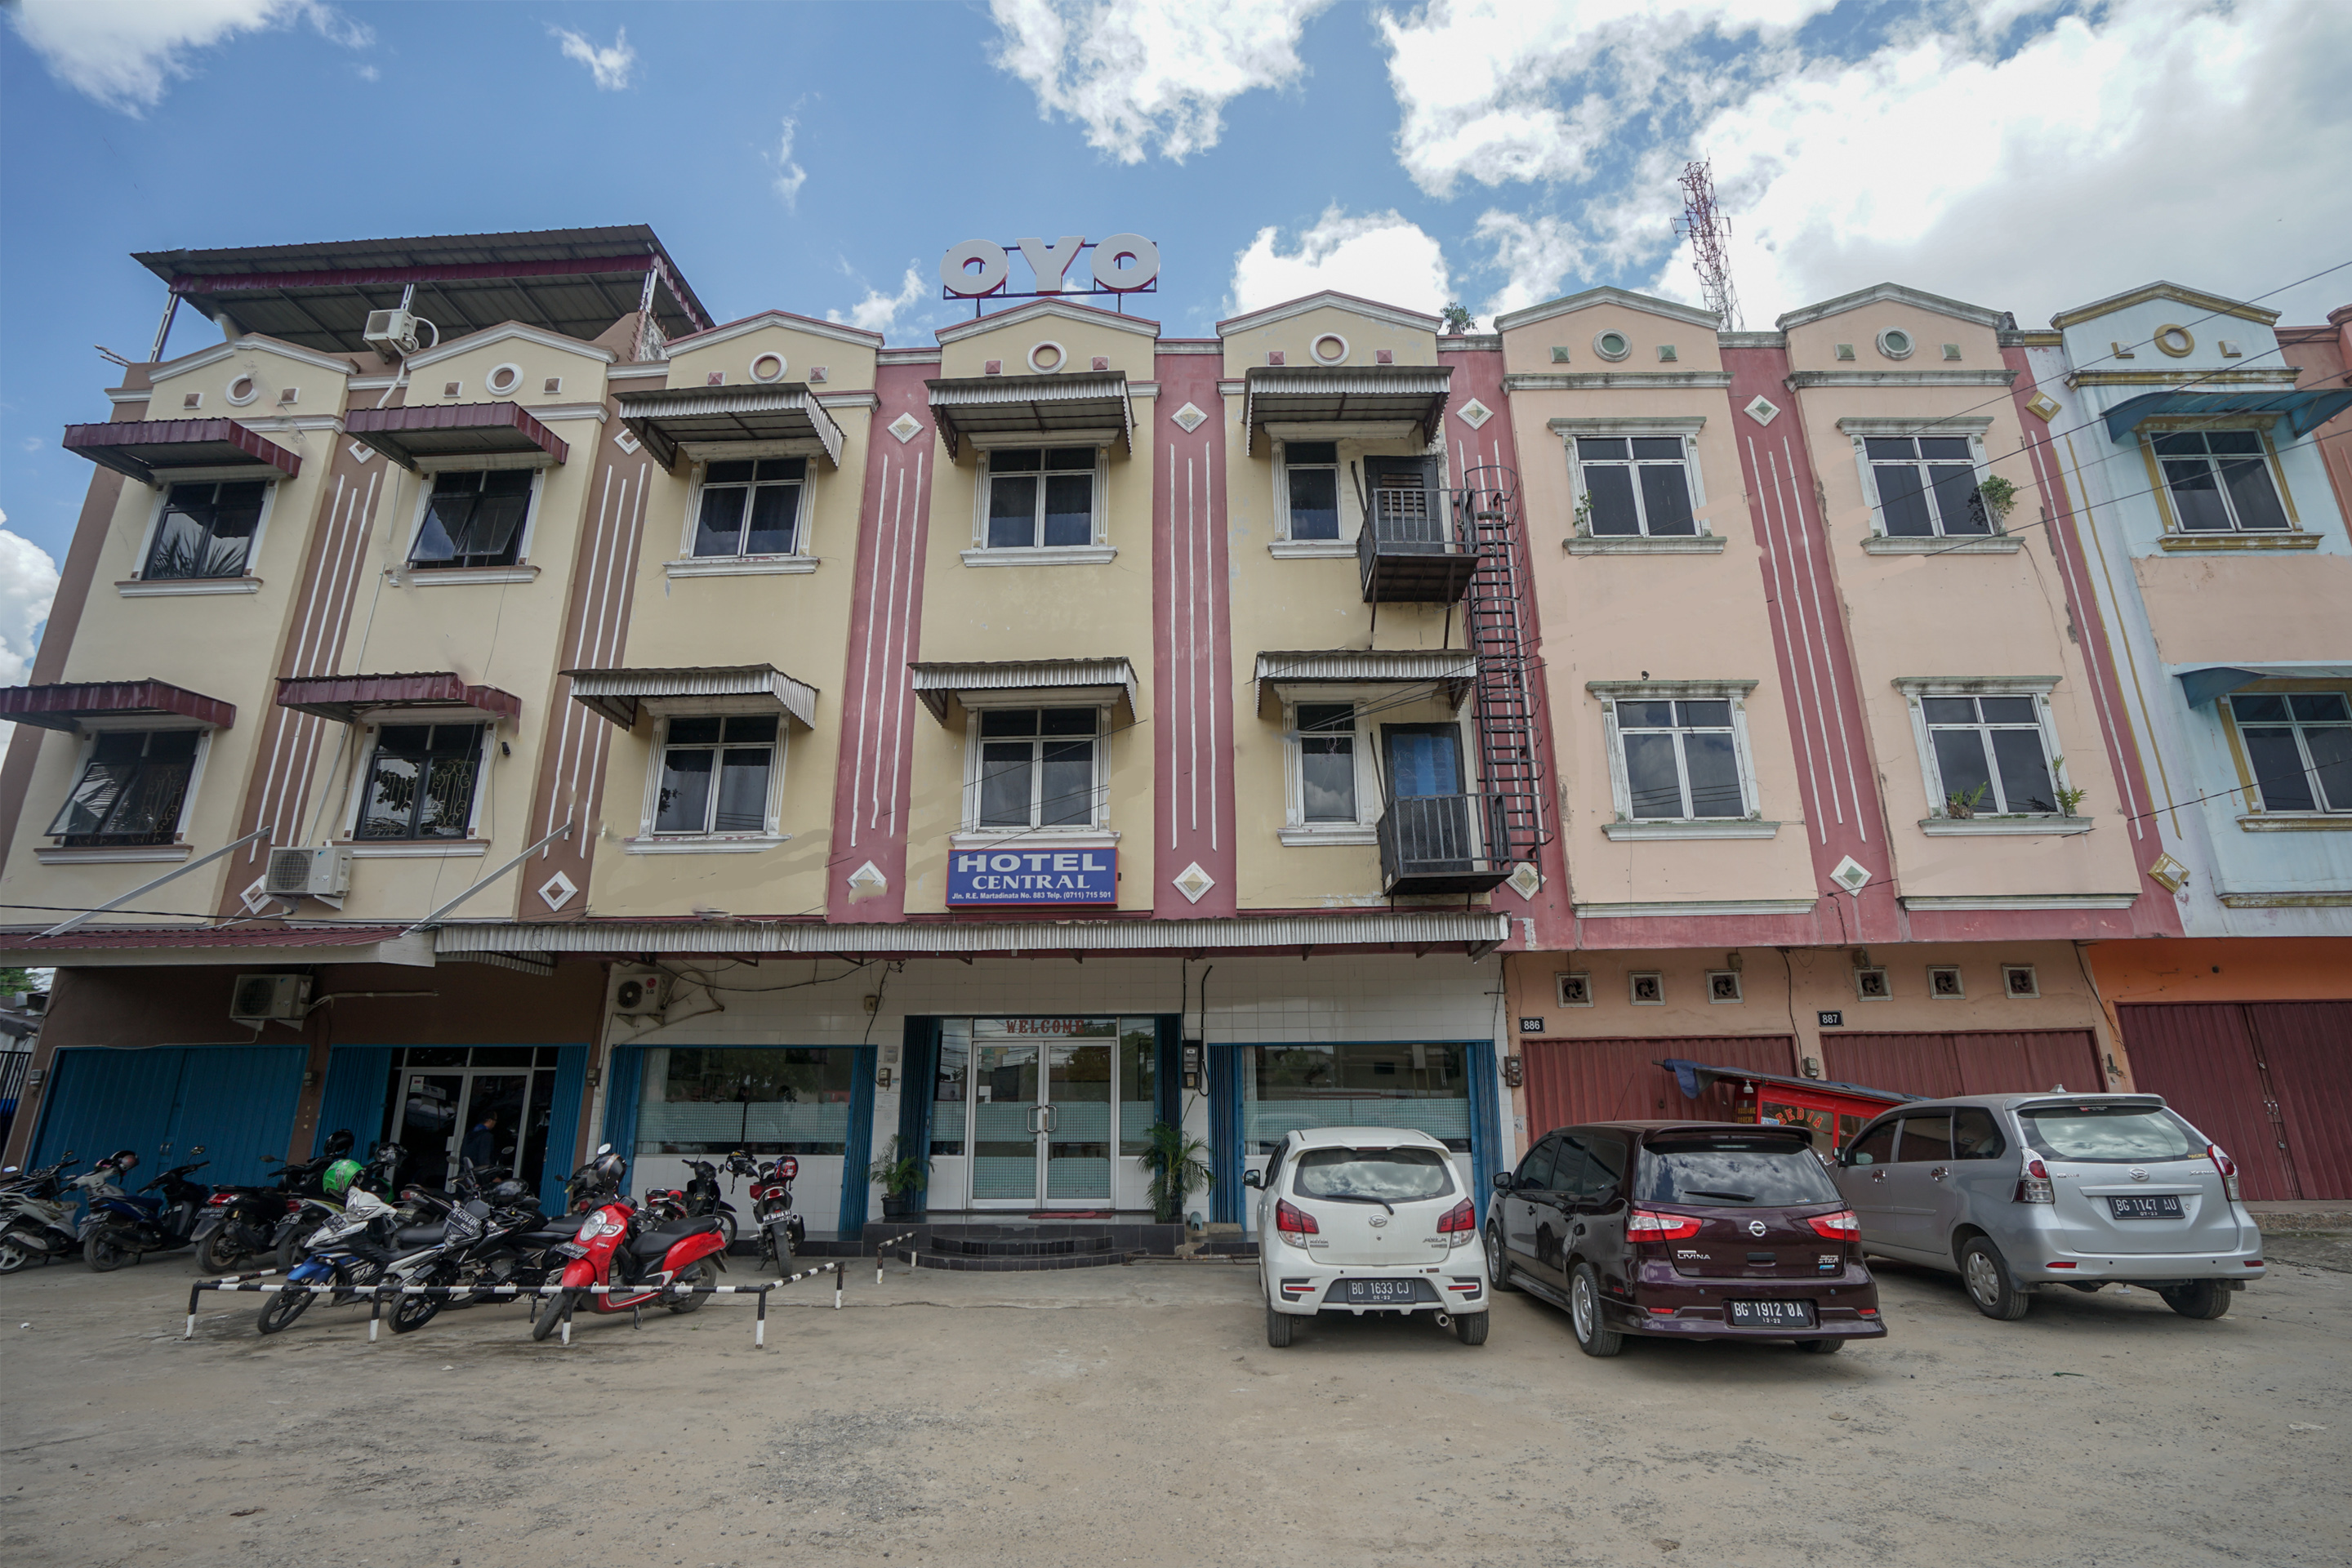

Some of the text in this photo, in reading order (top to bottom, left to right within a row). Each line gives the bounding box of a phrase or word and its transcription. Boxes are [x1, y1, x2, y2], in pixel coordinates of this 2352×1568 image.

[940, 233, 1160, 298] OYO
[958, 853, 1107, 872] HOTEL
[972, 875, 1090, 889] CENTRAL
[1046, 891, 1062, 900] Telp.
[1063, 891, 1084, 900] (0711)
[1524, 1020, 1540, 1031] 886
[1822, 1013, 1838, 1024] 887
[1005, 1019, 1085, 1034] WELCOME
[1775, 1107, 1824, 1129] SEDIA
[2115, 1198, 2177, 1211] BG 1147 AU
[1352, 1281, 1410, 1295] BD 1633 CJ
[1734, 1302, 1749, 1316] BG
[1755, 1302, 1782, 1316] 1912
